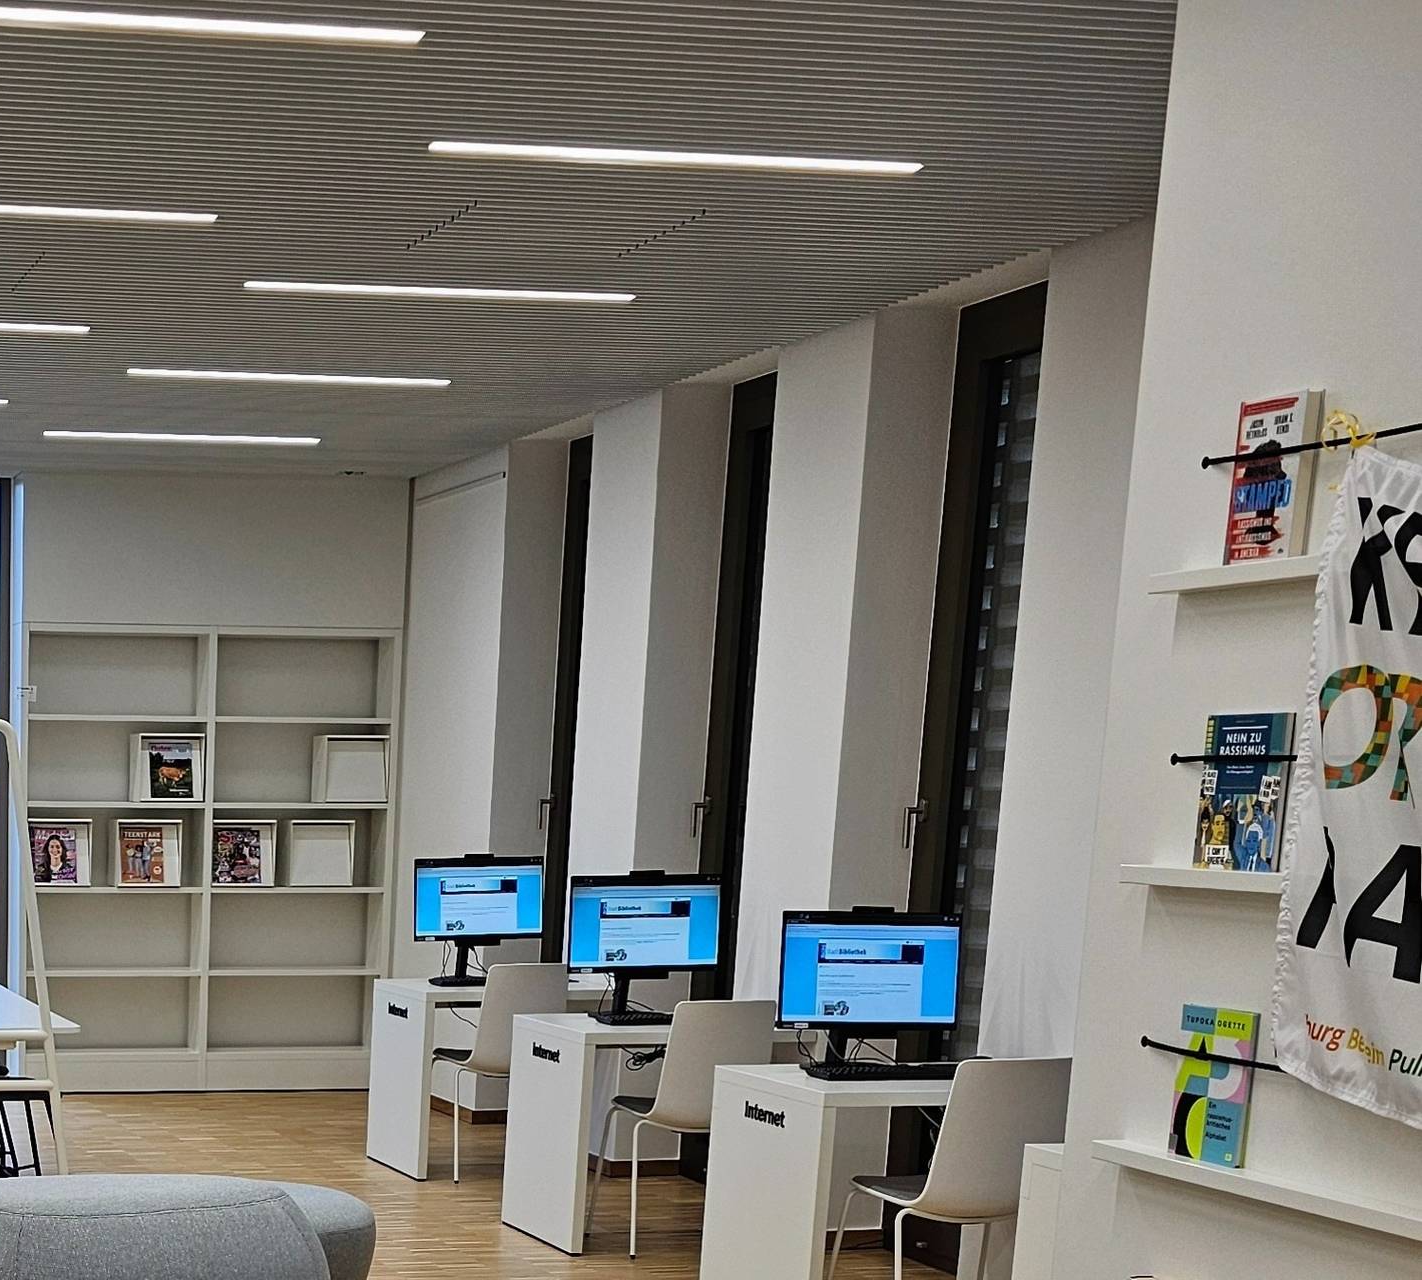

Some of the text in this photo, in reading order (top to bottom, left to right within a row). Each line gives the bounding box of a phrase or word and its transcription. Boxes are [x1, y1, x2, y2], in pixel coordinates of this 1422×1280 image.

[1234, 479, 1293, 514] STAMPED
[1225, 732, 1263, 744] NEIN ZU
[1218, 744, 1266, 756] RASSISMUS
[387, 1001, 409, 1019] Internet
[1186, 1014, 1246, 1031] TUPOKA OGETTE
[532, 1041, 561, 1064] Internet
[744, 1100, 786, 1129] Internet
